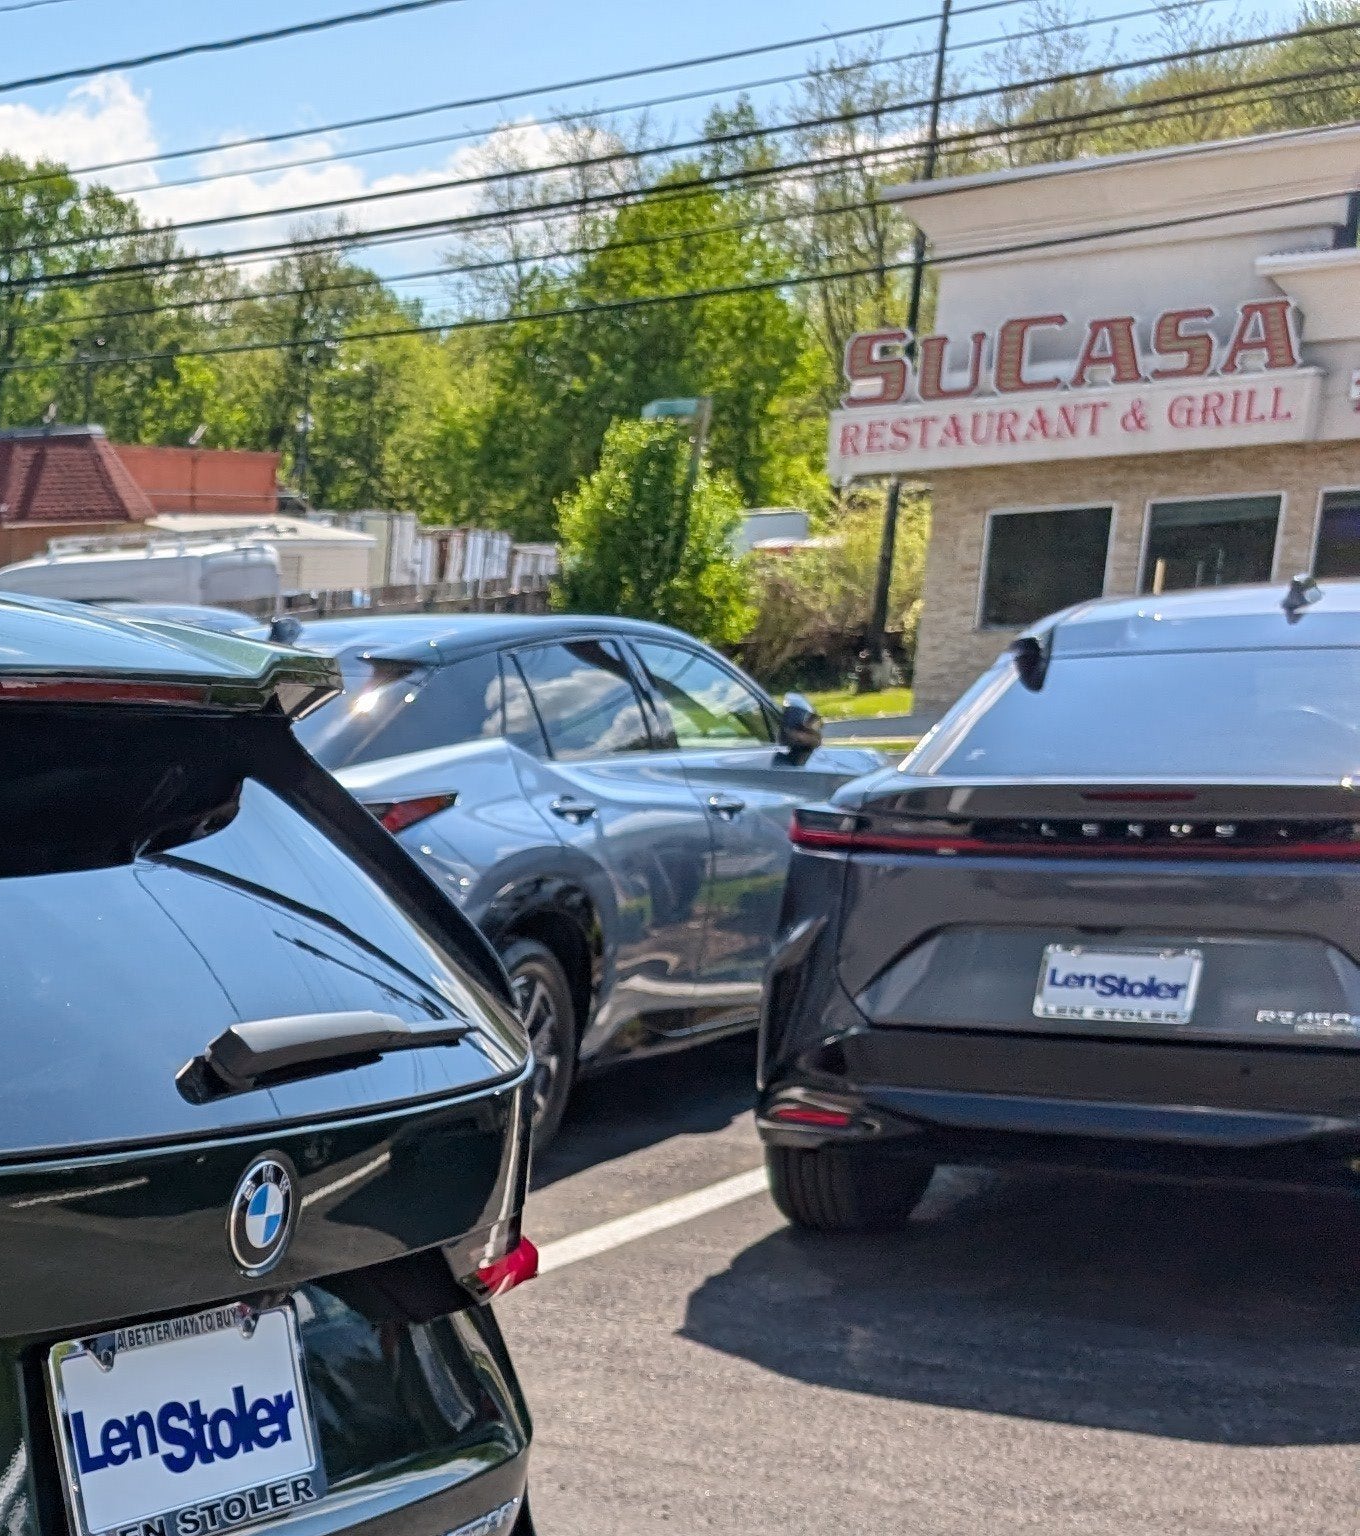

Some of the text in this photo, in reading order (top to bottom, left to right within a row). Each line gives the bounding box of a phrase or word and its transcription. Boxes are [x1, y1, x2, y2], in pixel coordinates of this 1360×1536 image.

[839, 387, 1292, 456] RESTAURANT & GRILL
[1048, 967, 1186, 1001] LenStoler
[129, 1321, 170, 1347] BETTER
[172, 1318, 197, 1339] WAY
[198, 1312, 213, 1334] TO
[215, 1307, 239, 1329] BUY
[71, 1385, 294, 1474] LenStoler
